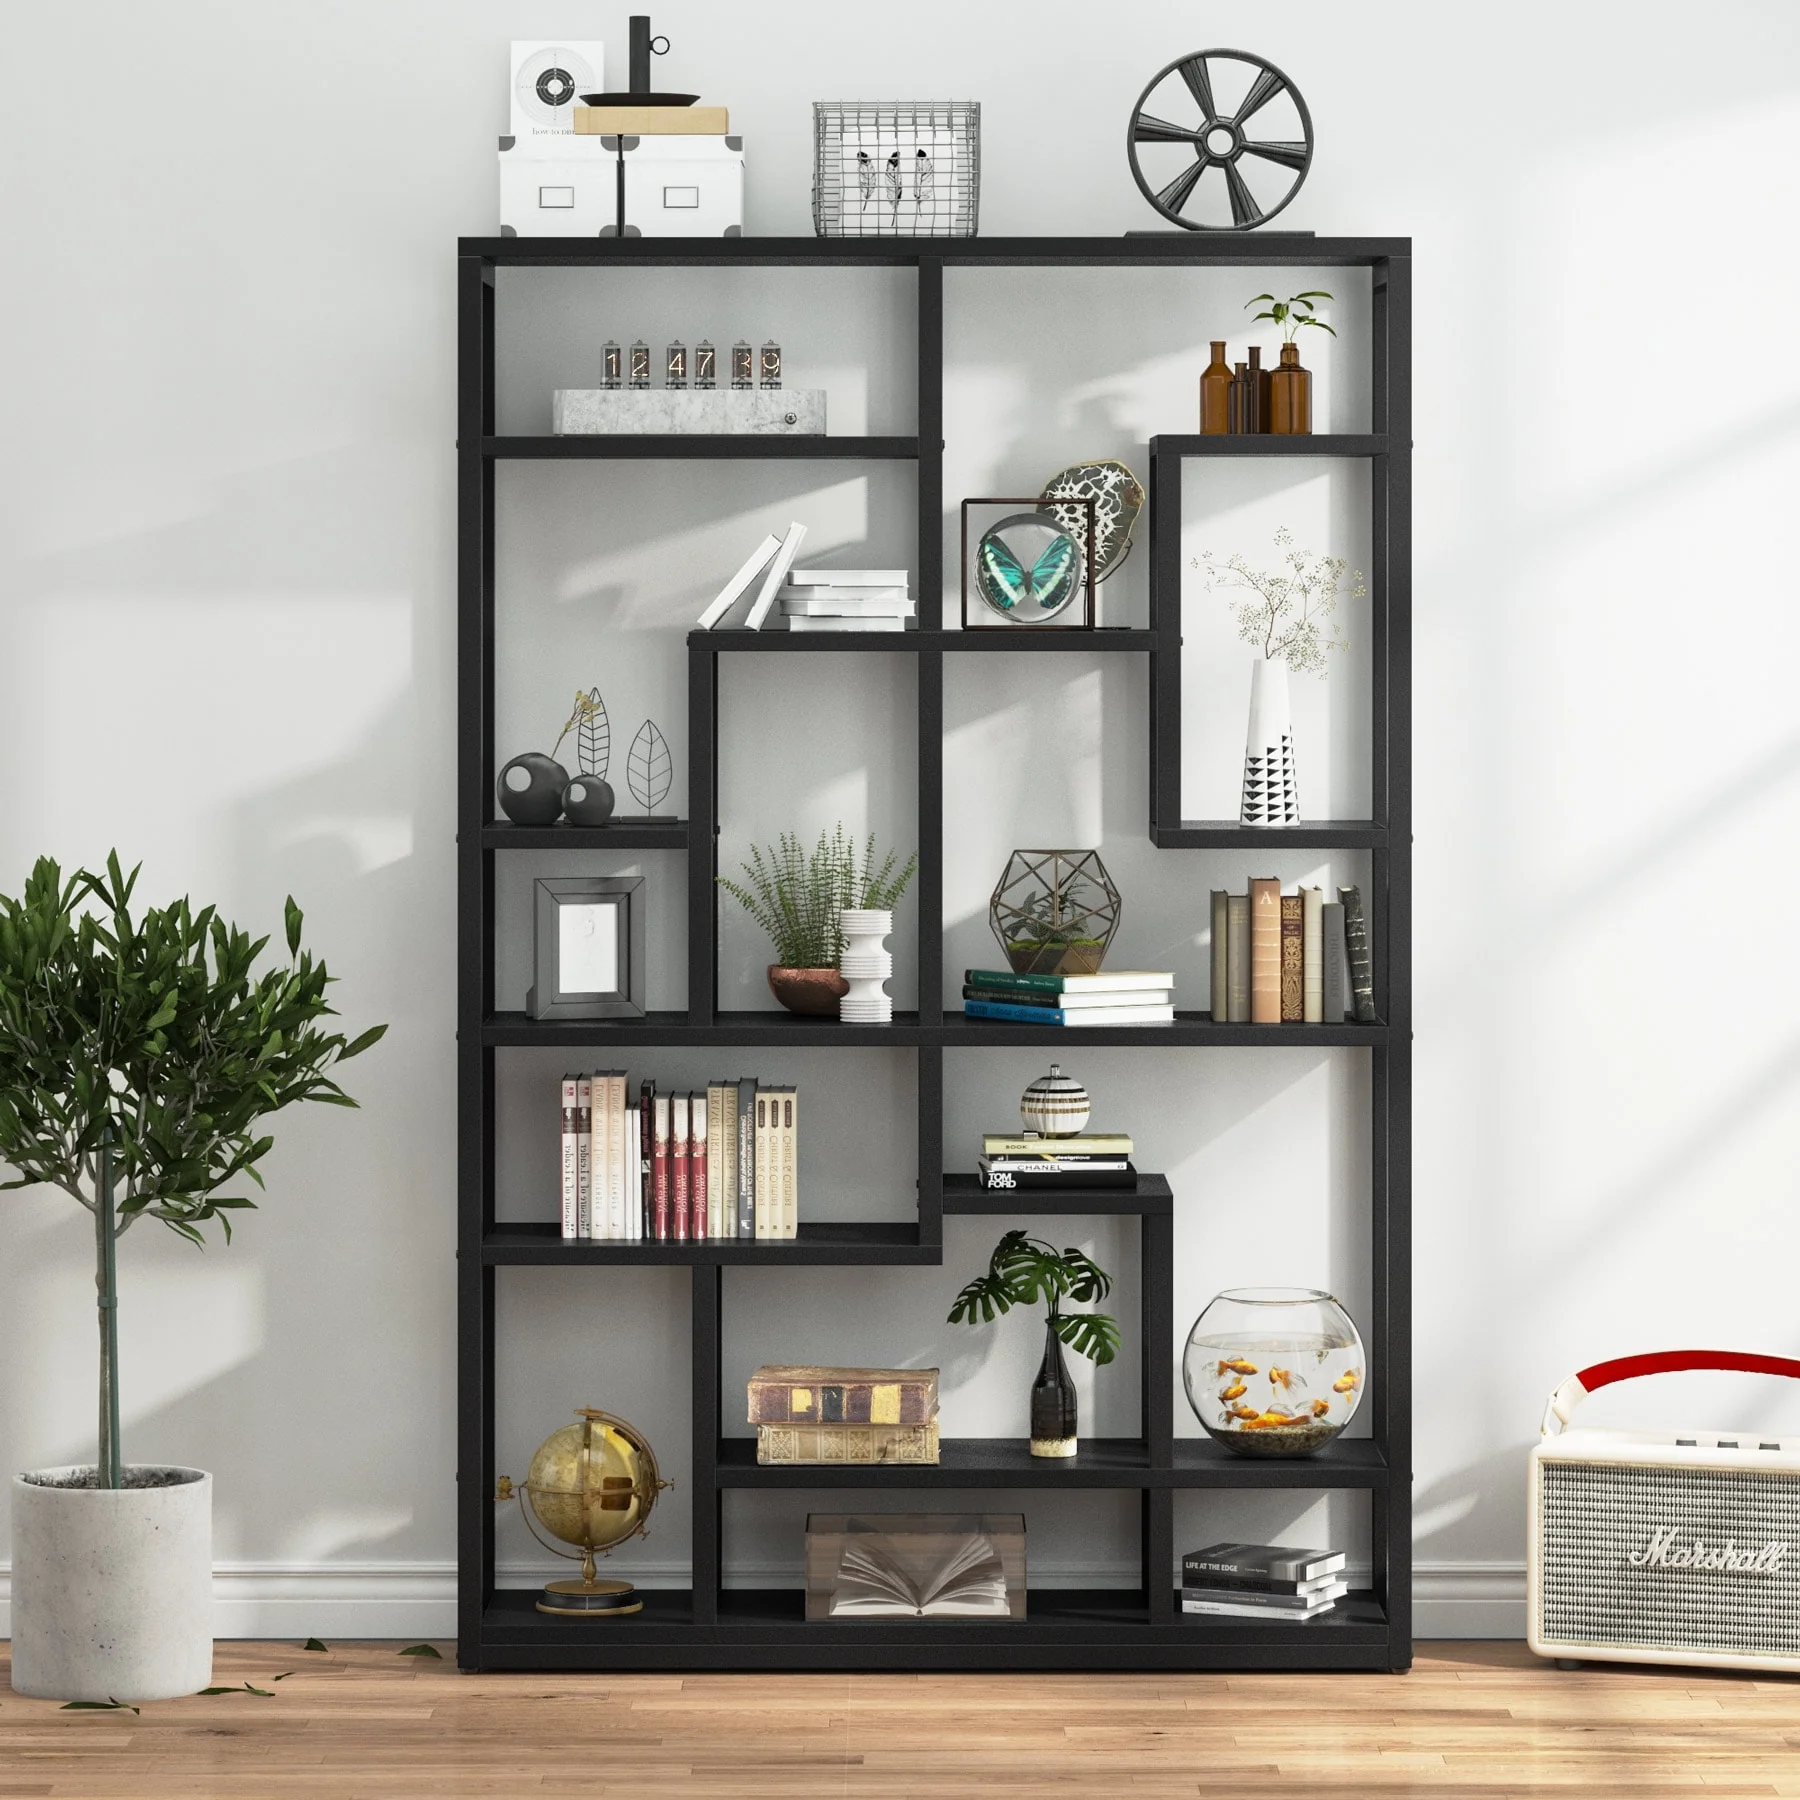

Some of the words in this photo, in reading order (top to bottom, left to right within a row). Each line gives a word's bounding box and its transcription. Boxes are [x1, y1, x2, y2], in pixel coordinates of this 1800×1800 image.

[532, 127, 548, 135] how
[1259, 891, 1273, 905] A
[988, 1172, 1012, 1181] TOM
[987, 1180, 1017, 1188] FORD
[1628, 1526, 1788, 1573] Marshall
[1185, 1561, 1199, 1569] LIFE
[1208, 1563, 1220, 1571] THE
[1221, 1563, 1238, 1572] EDGE
